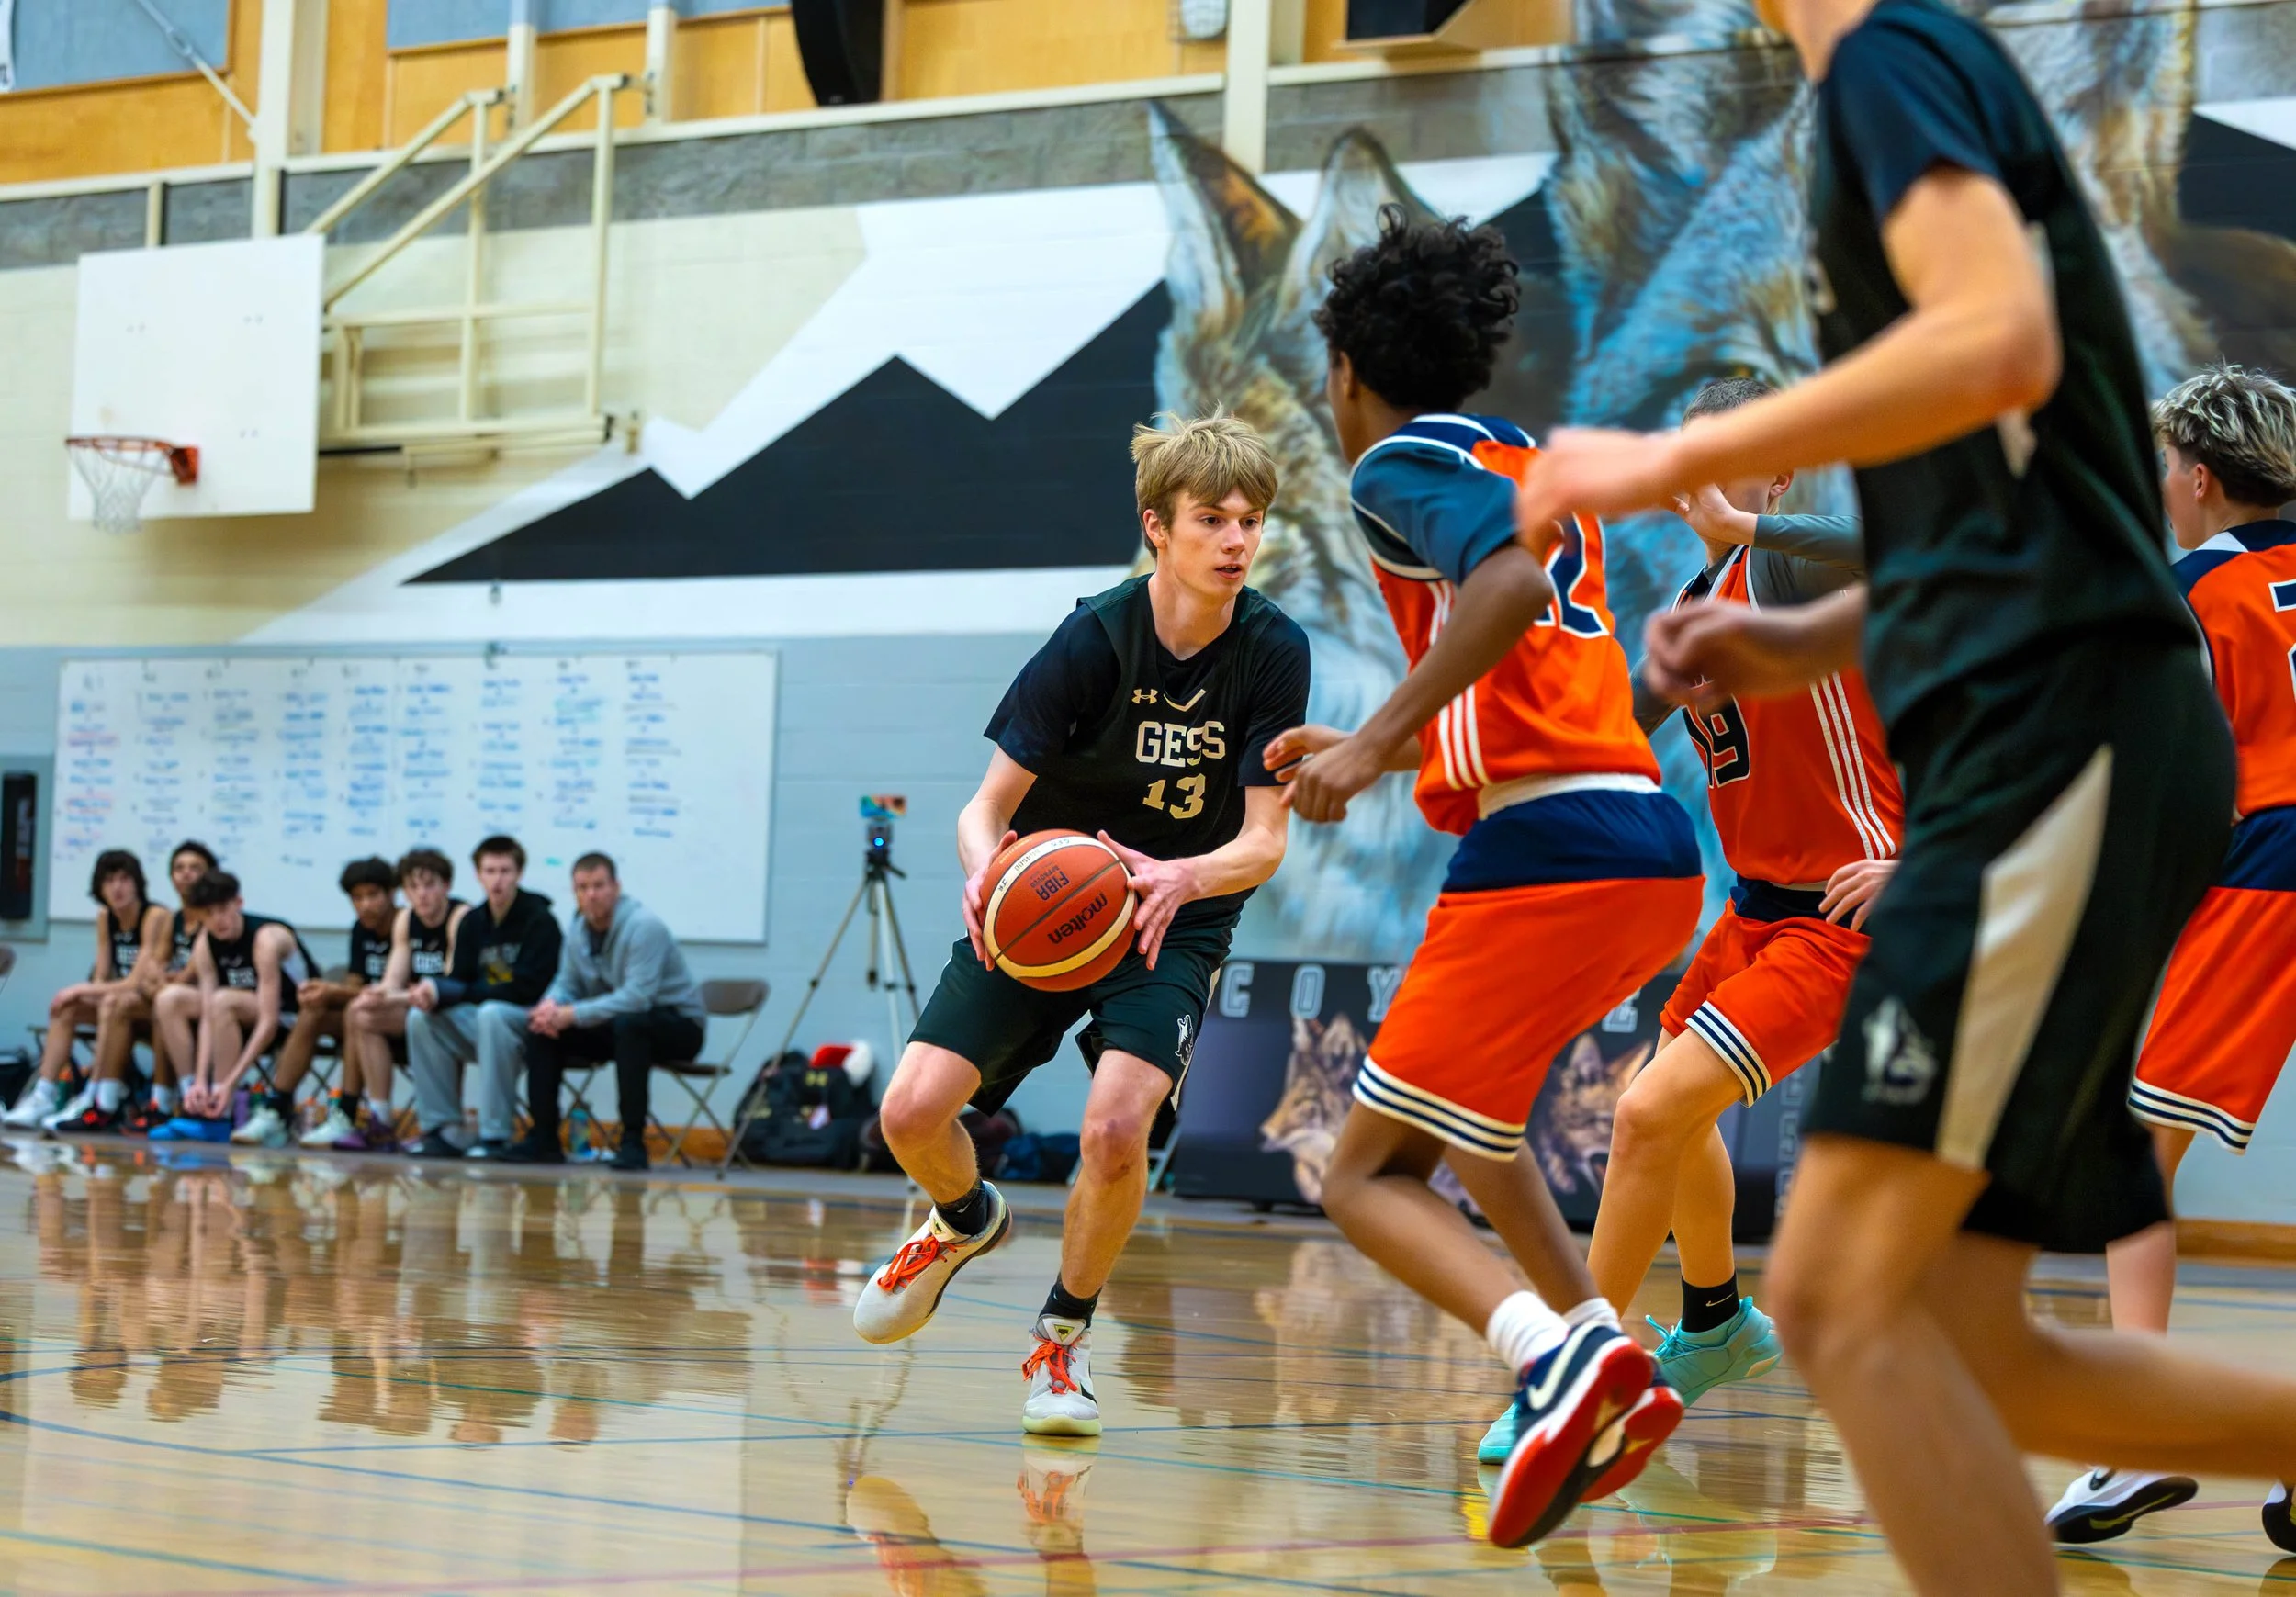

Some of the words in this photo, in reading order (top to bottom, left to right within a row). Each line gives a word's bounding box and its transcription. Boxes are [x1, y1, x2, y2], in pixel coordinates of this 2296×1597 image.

[1135, 721, 1226, 768] GESS
[1142, 773, 1206, 819] 13
[1035, 871, 1070, 901] FIBA
[1047, 893, 1109, 944] molten
